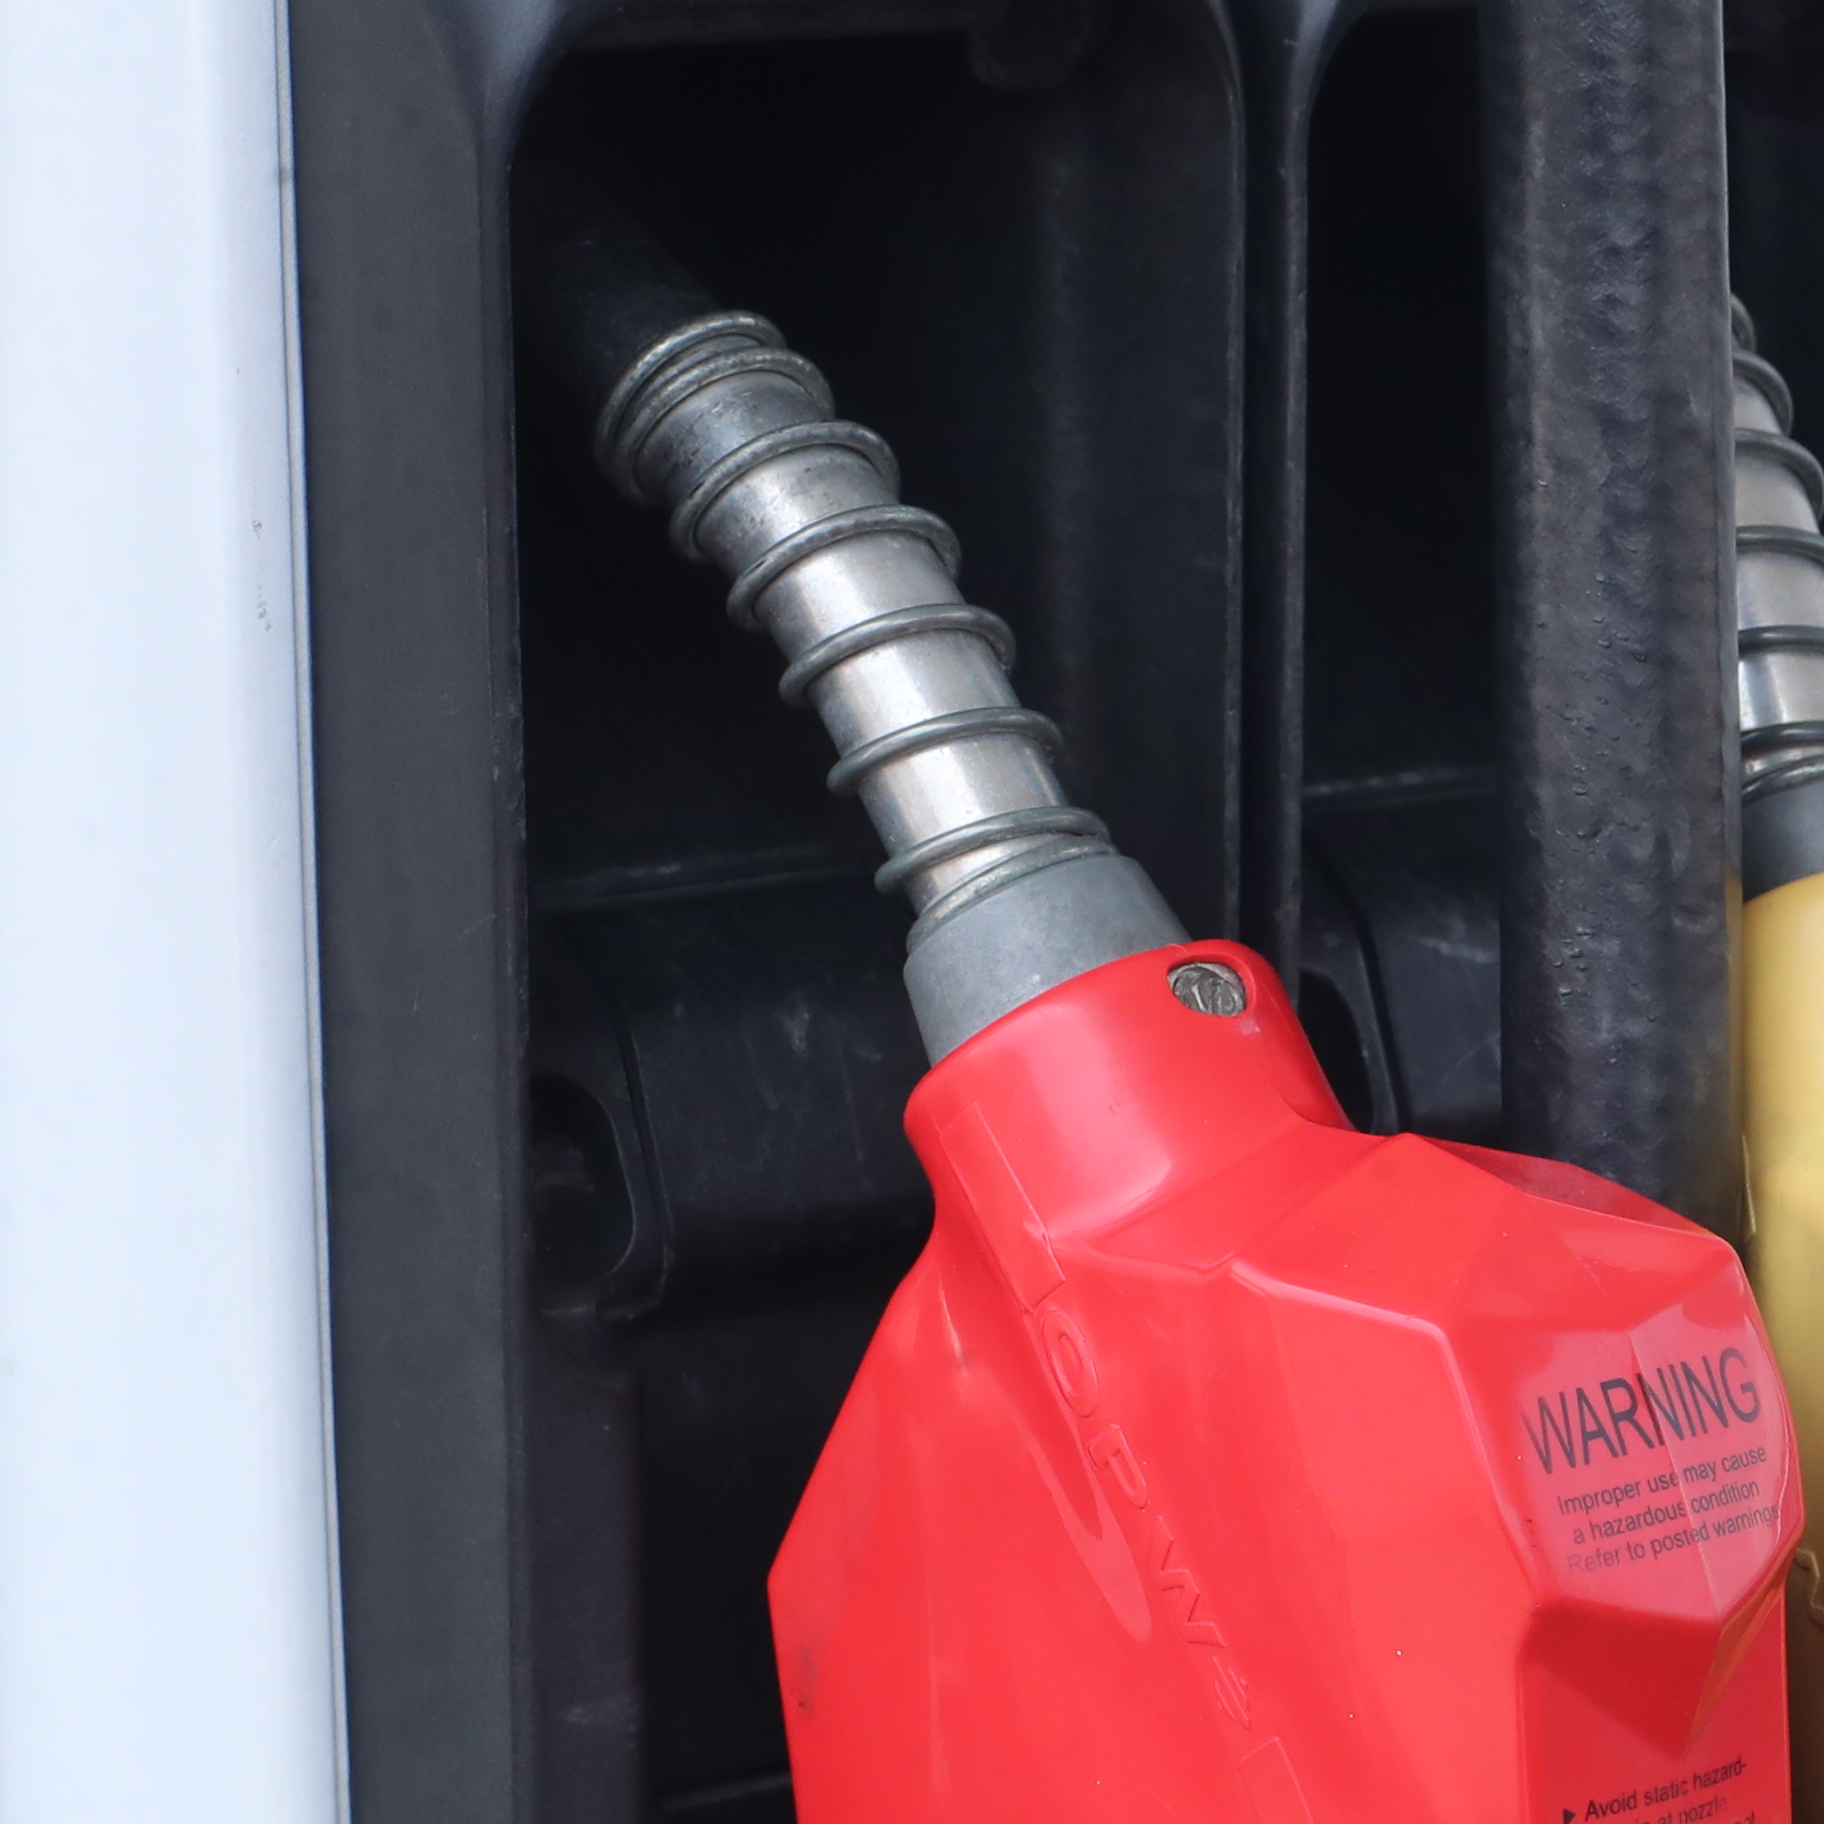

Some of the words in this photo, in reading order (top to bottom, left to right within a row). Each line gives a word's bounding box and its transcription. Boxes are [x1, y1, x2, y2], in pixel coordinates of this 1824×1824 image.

[1521, 1346, 1762, 1475] WARNING
[1557, 1480, 1641, 1515] Improper
[1647, 1471, 1679, 1493] use
[1683, 1461, 1717, 1484] may
[1721, 1447, 1767, 1472] cause
[1573, 1528, 1585, 1544] a
[1589, 1502, 1686, 1541] hazardous
[1691, 1480, 1759, 1514] condition
[1567, 1549, 1620, 1574] Refer
[1627, 1541, 1646, 1560] to
[1650, 1523, 1710, 1559] posted
[1712, 1504, 1779, 1538] warnings
[1585, 1789, 1638, 1821] Avoid
[1643, 1778, 1689, 1807] static
